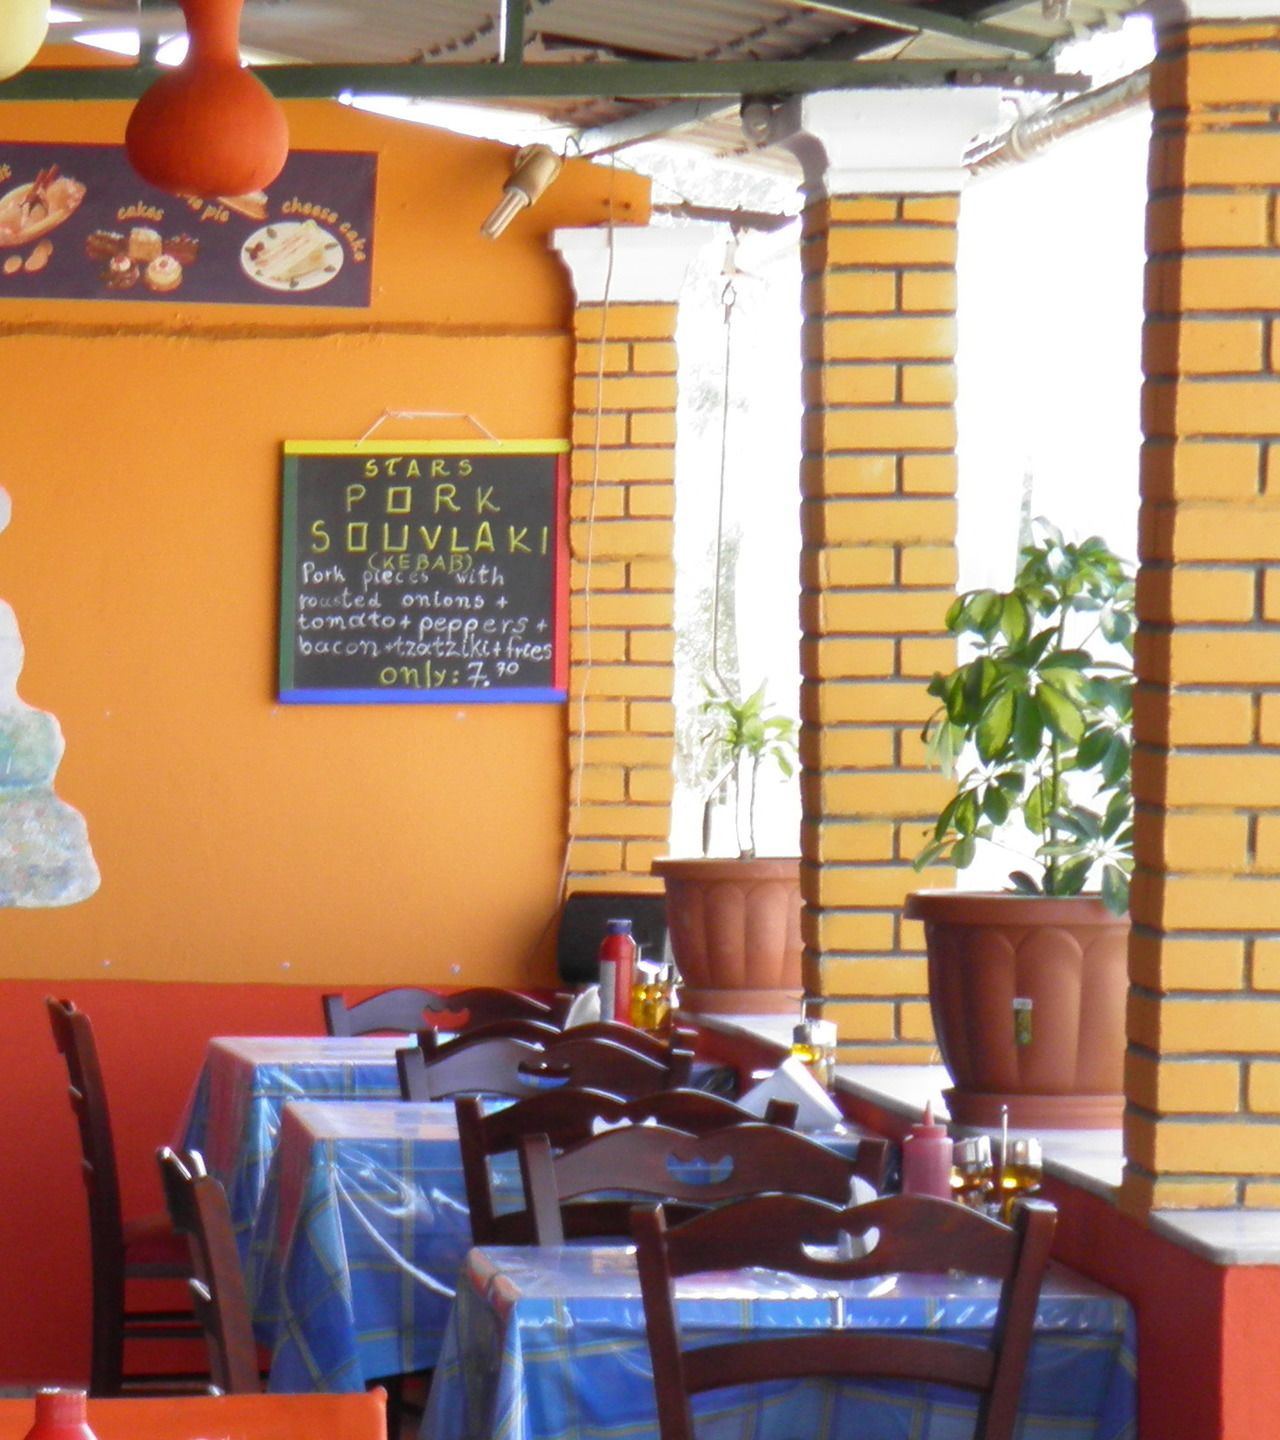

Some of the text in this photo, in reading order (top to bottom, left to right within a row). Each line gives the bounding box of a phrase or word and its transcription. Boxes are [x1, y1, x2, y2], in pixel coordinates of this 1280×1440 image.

[117, 199, 165, 222] cakes
[200, 204, 230, 223] pie
[281, 196, 367, 262] cheese cake
[364, 457, 473, 477] STARS
[346, 483, 501, 513] PORK
[311, 519, 549, 554] SOUVLAKI
[367, 551, 474, 573] (KEBAB)
[302, 561, 505, 592] Pork pieces with
[401, 590, 485, 609] onions
[418, 616, 528, 641] peppers
[298, 634, 379, 657] bacon
